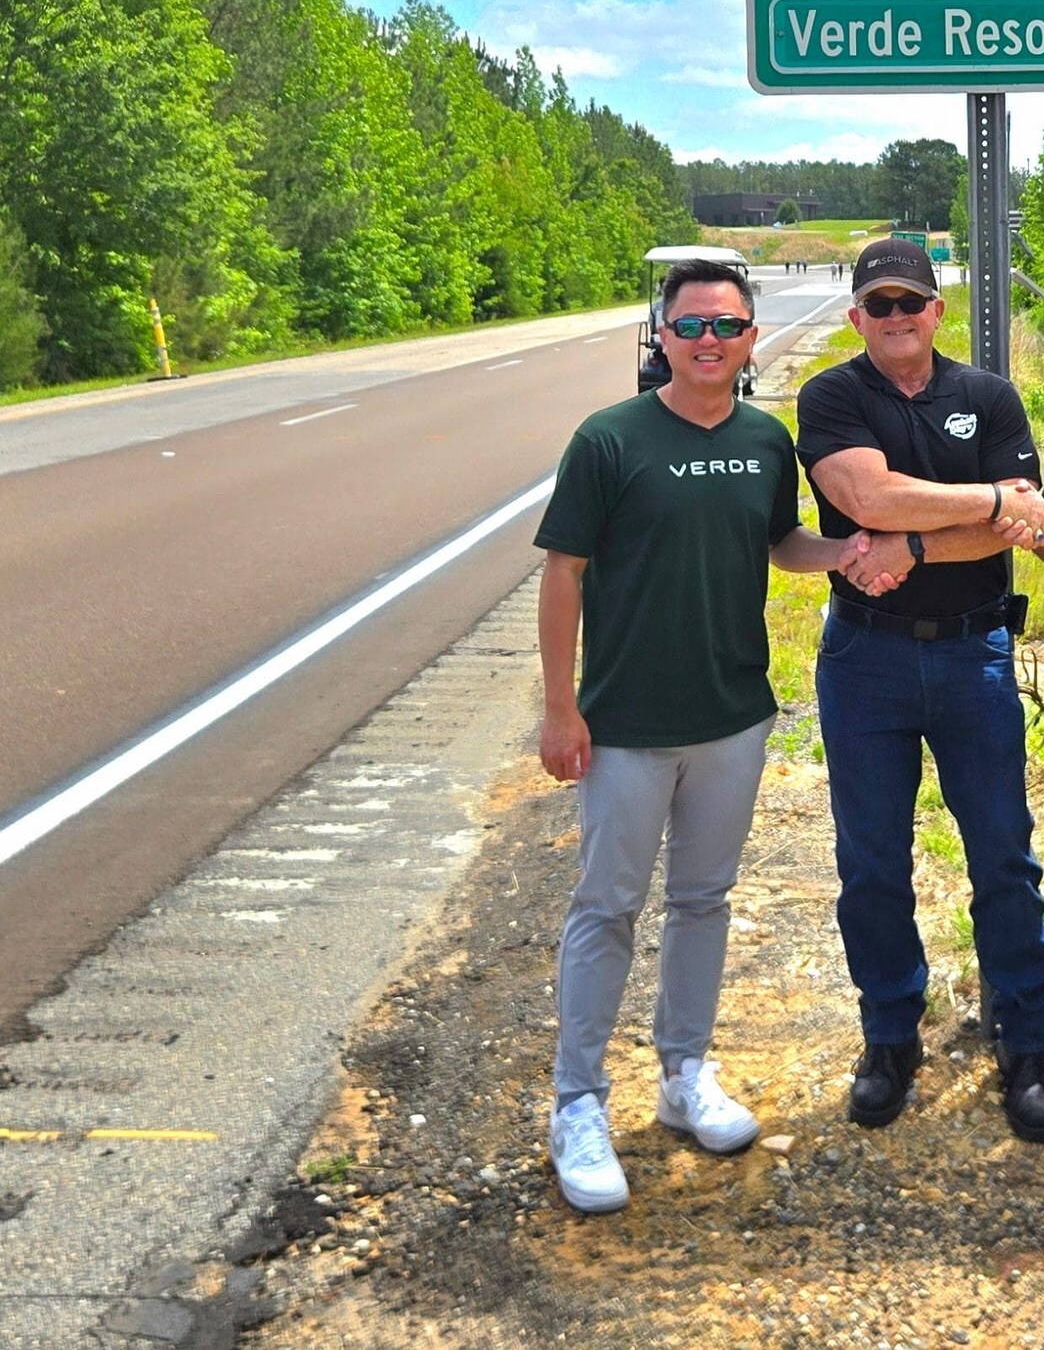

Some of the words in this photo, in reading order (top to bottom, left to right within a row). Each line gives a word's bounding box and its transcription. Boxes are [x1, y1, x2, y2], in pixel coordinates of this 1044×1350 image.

[788, 9, 922, 57] Verde
[874, 255, 919, 267] ASPHALT
[669, 459, 761, 477] VERDE
